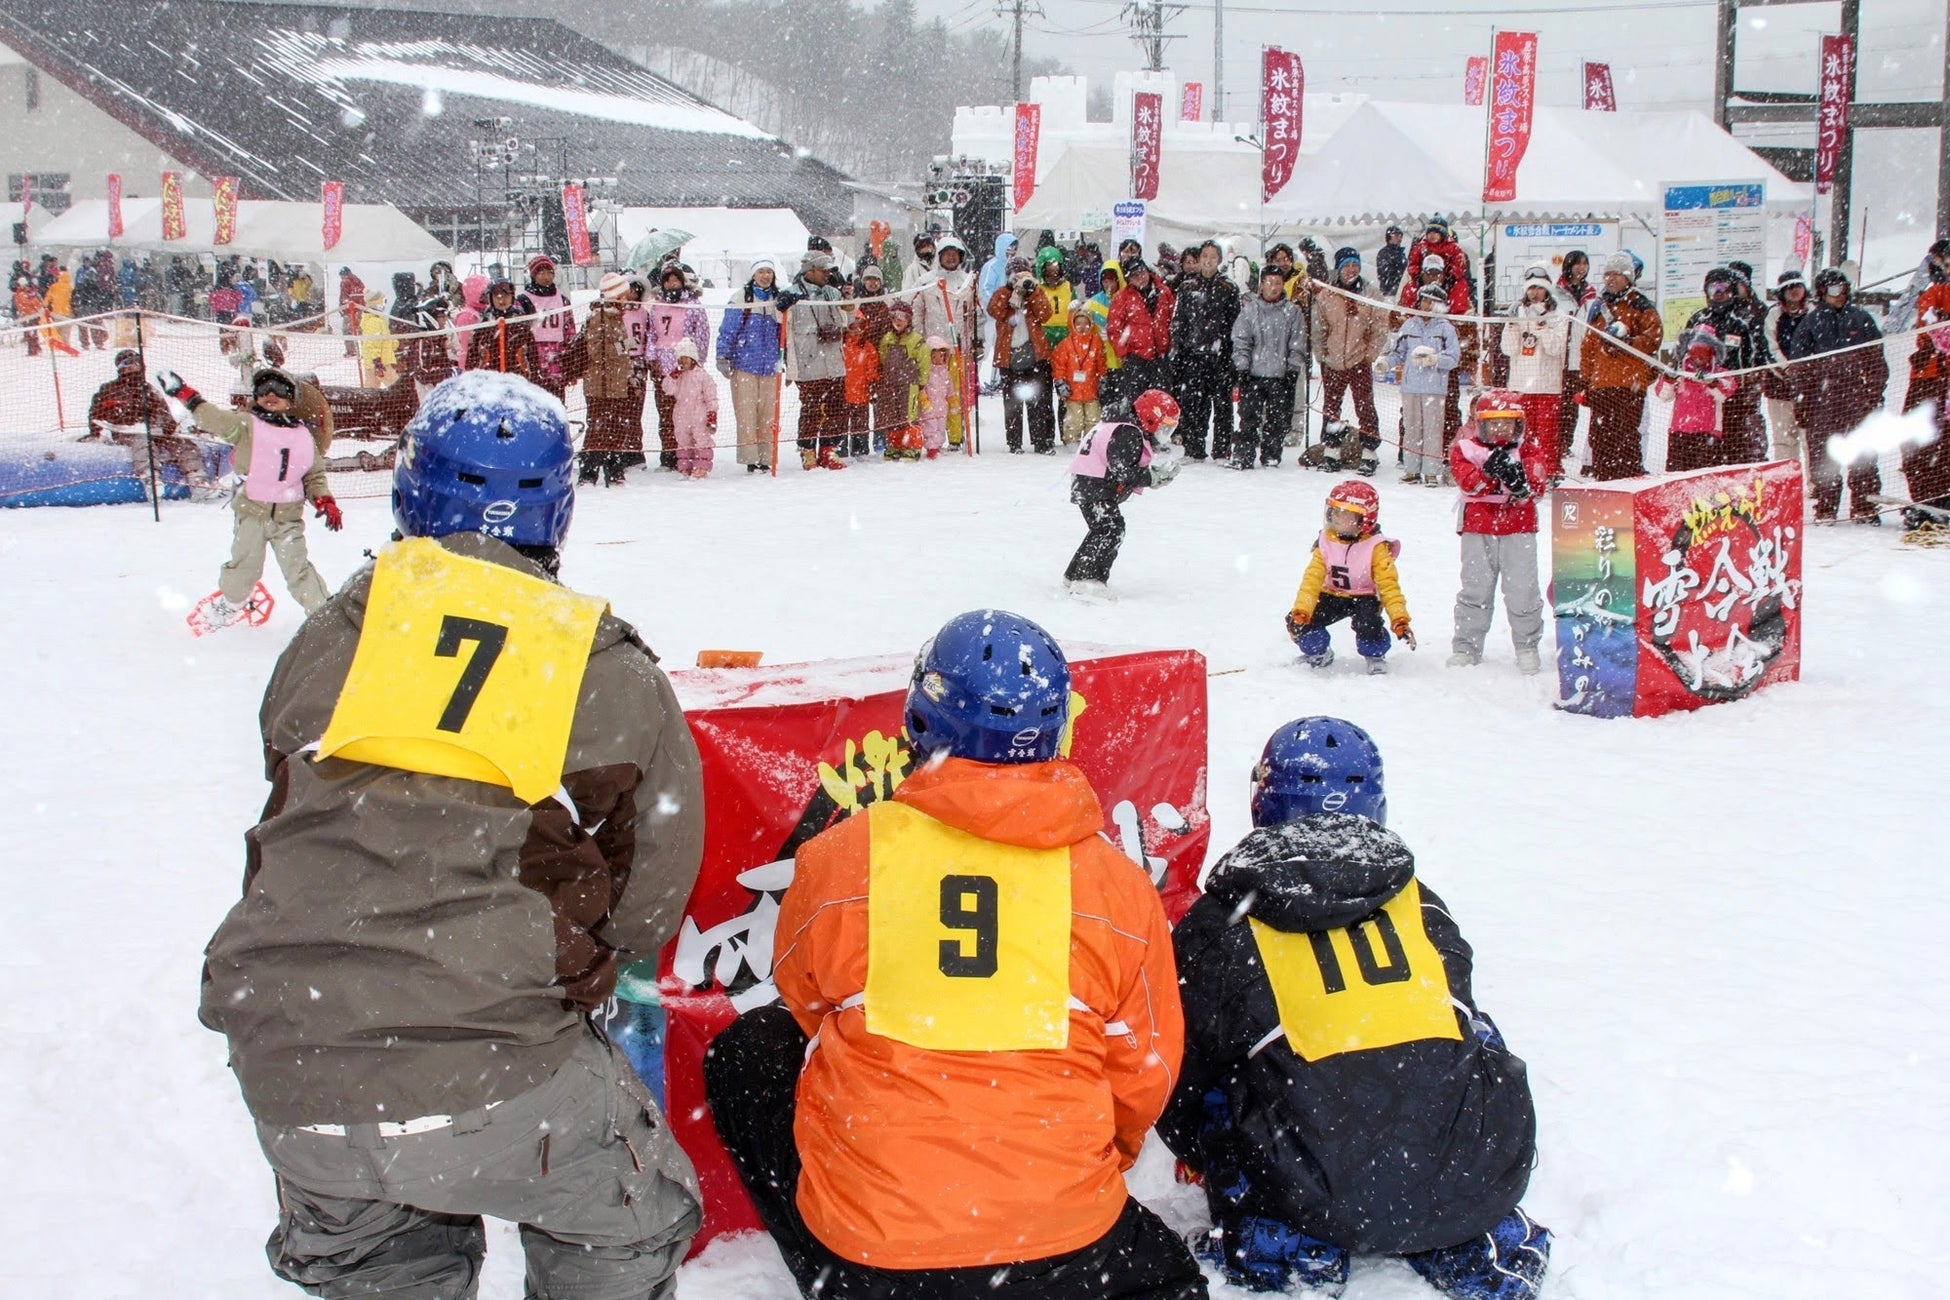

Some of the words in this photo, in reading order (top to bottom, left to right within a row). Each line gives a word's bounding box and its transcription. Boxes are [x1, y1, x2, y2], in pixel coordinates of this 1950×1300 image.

[1135, 106, 1152, 194] 氷紋まつり
[1270, 67, 1291, 183] 氷紋まつり
[1495, 50, 1522, 179] 氷紋まつり
[1820, 54, 1841, 173] 氷紋まつり
[661, 316, 672, 336] 7
[278, 448, 290, 482] 1
[1330, 564, 1352, 590] 5
[1642, 525, 1802, 636] 雪合戦
[434, 614, 509, 734] 7
[938, 874, 999, 979] 9
[1305, 906, 1413, 996] 10
